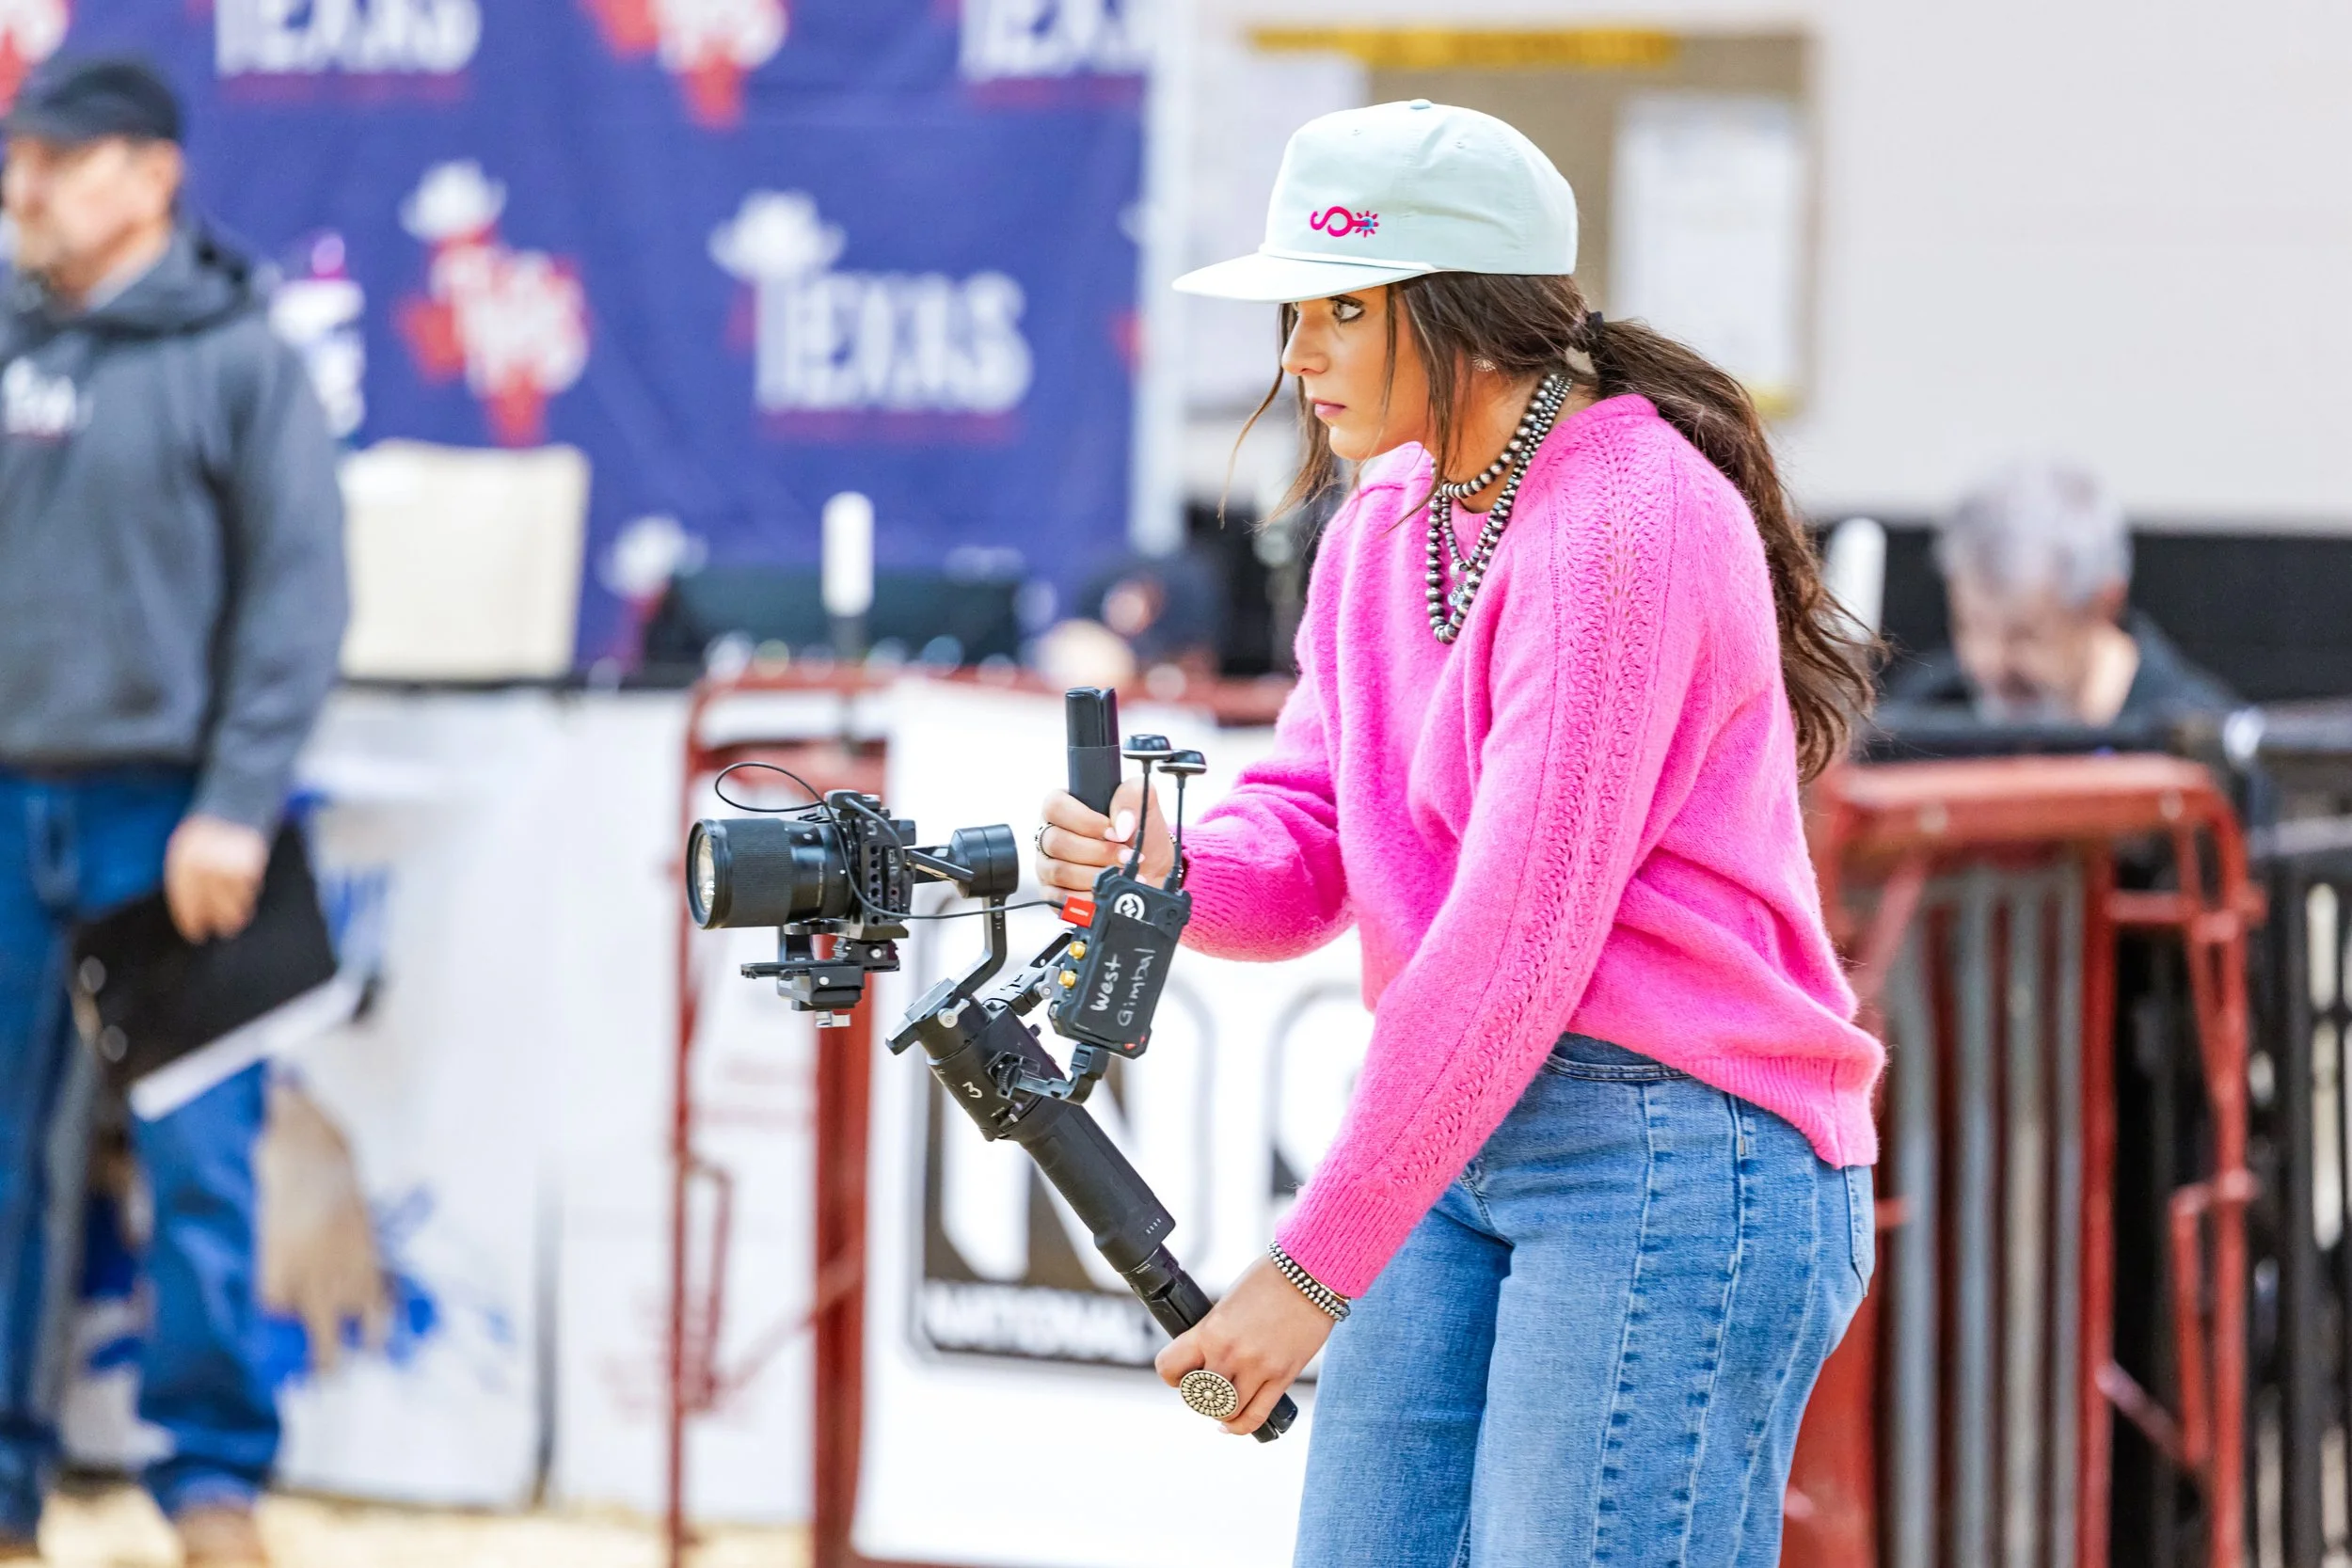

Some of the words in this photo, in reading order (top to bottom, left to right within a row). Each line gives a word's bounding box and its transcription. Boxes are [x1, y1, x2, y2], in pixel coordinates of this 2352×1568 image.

[755, 271, 1034, 413] TEXAS
[1117, 947, 1156, 1026] Gimbal
[961, 1081, 983, 1099] 3
